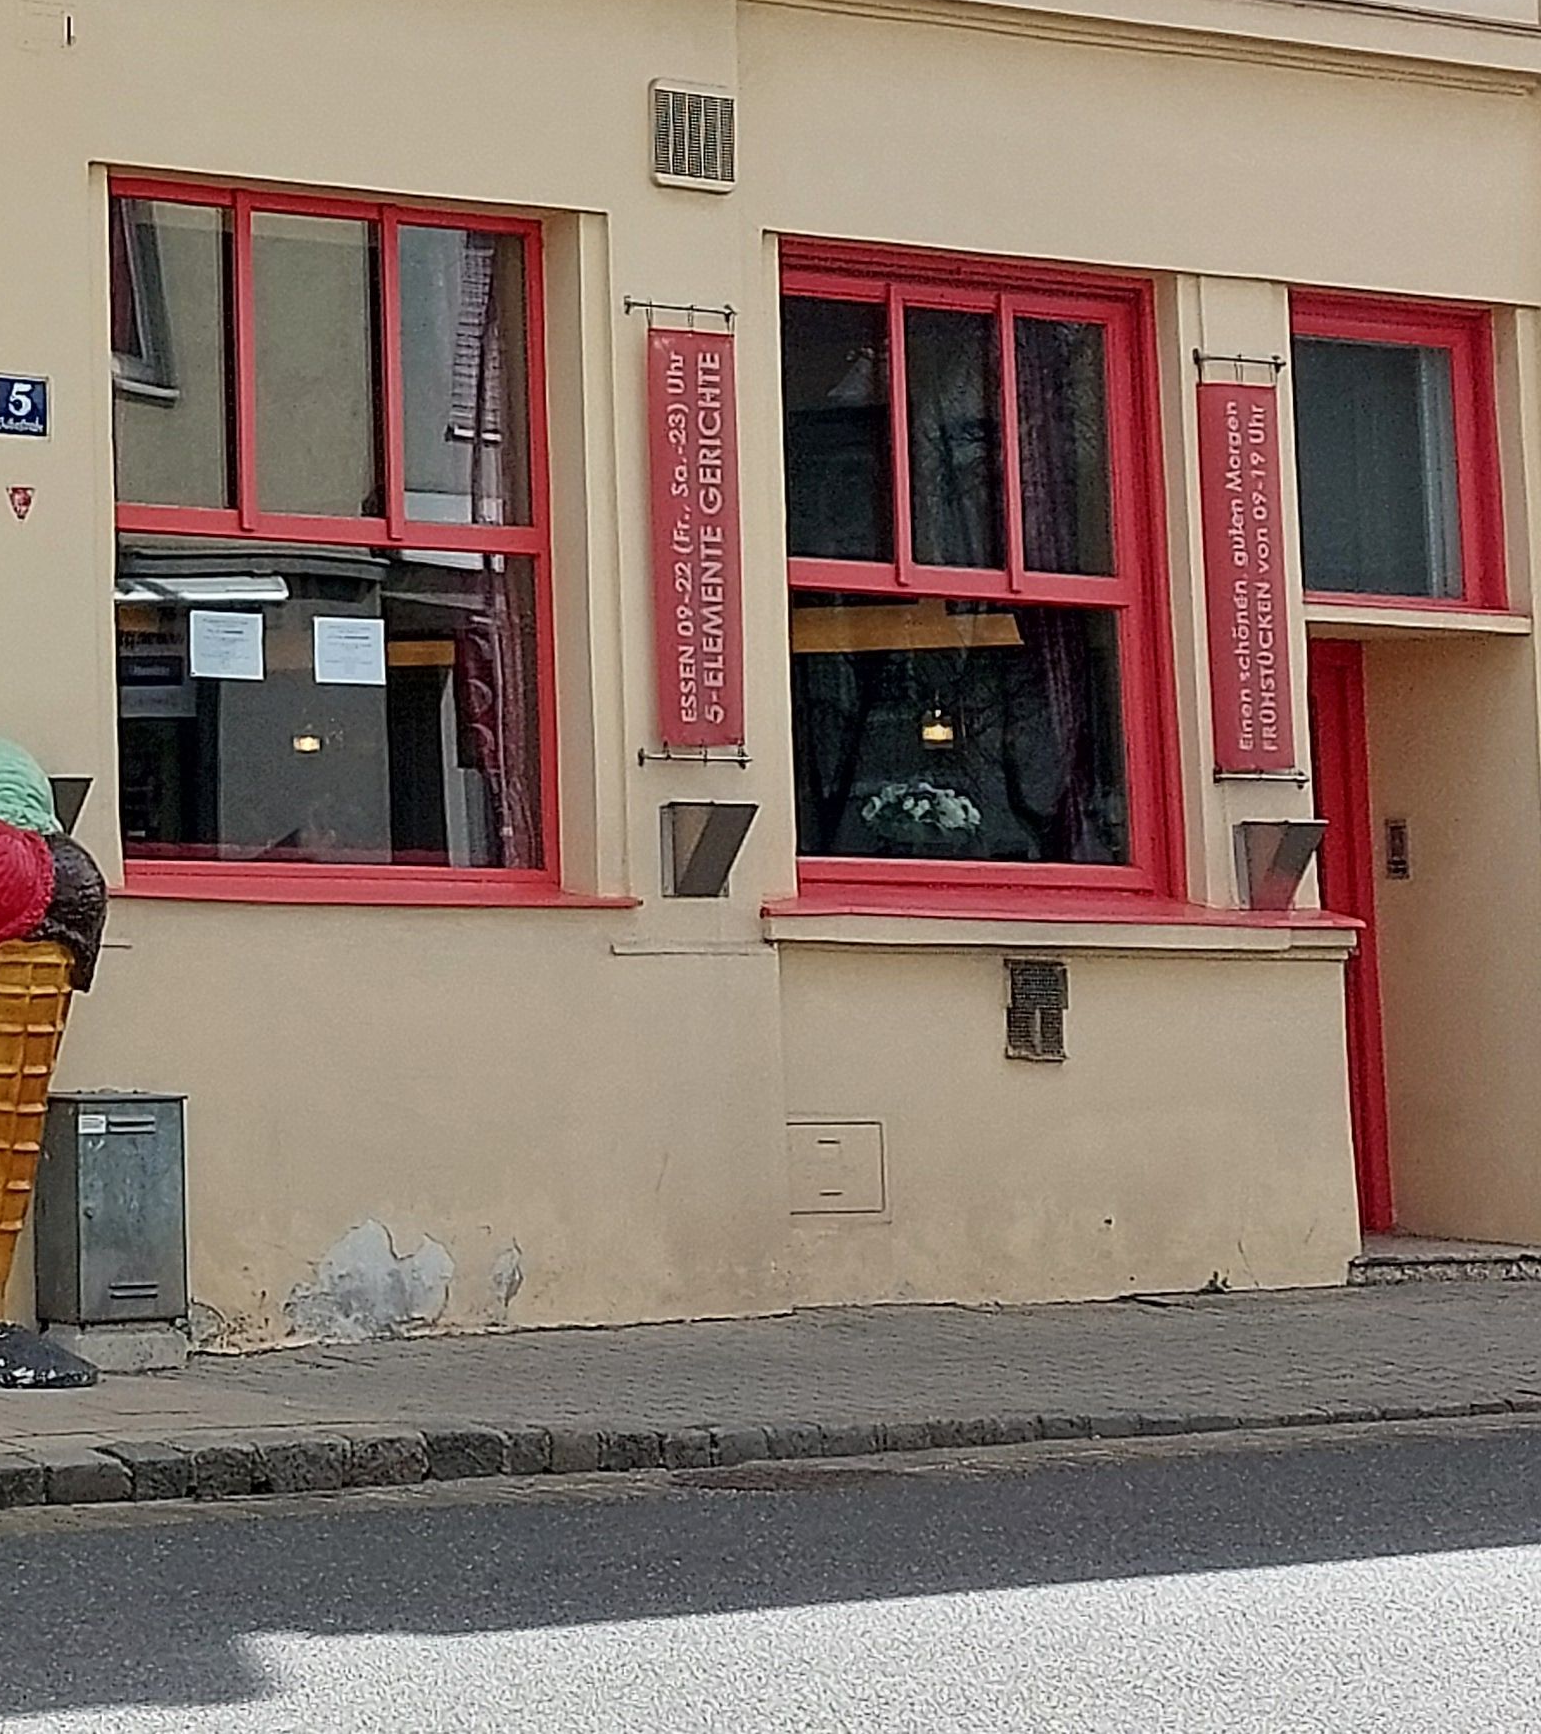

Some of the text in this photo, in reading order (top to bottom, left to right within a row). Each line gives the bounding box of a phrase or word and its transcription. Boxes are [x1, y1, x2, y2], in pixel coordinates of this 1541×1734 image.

[8, 382, 32, 416] 5
[667, 352, 686, 391] Uhr
[1224, 400, 1243, 492] Morgen
[1248, 404, 1266, 443] Uhr
[1250, 452, 1269, 517] 09-19
[697, 350, 725, 724] 5-ELEMENTE GERICHTE
[1228, 499, 1250, 567] guten
[1255, 527, 1270, 574] von
[675, 561, 695, 637] 09-22
[680, 645, 698, 724] ESSEN
[1239, 689, 1254, 751] Einen
